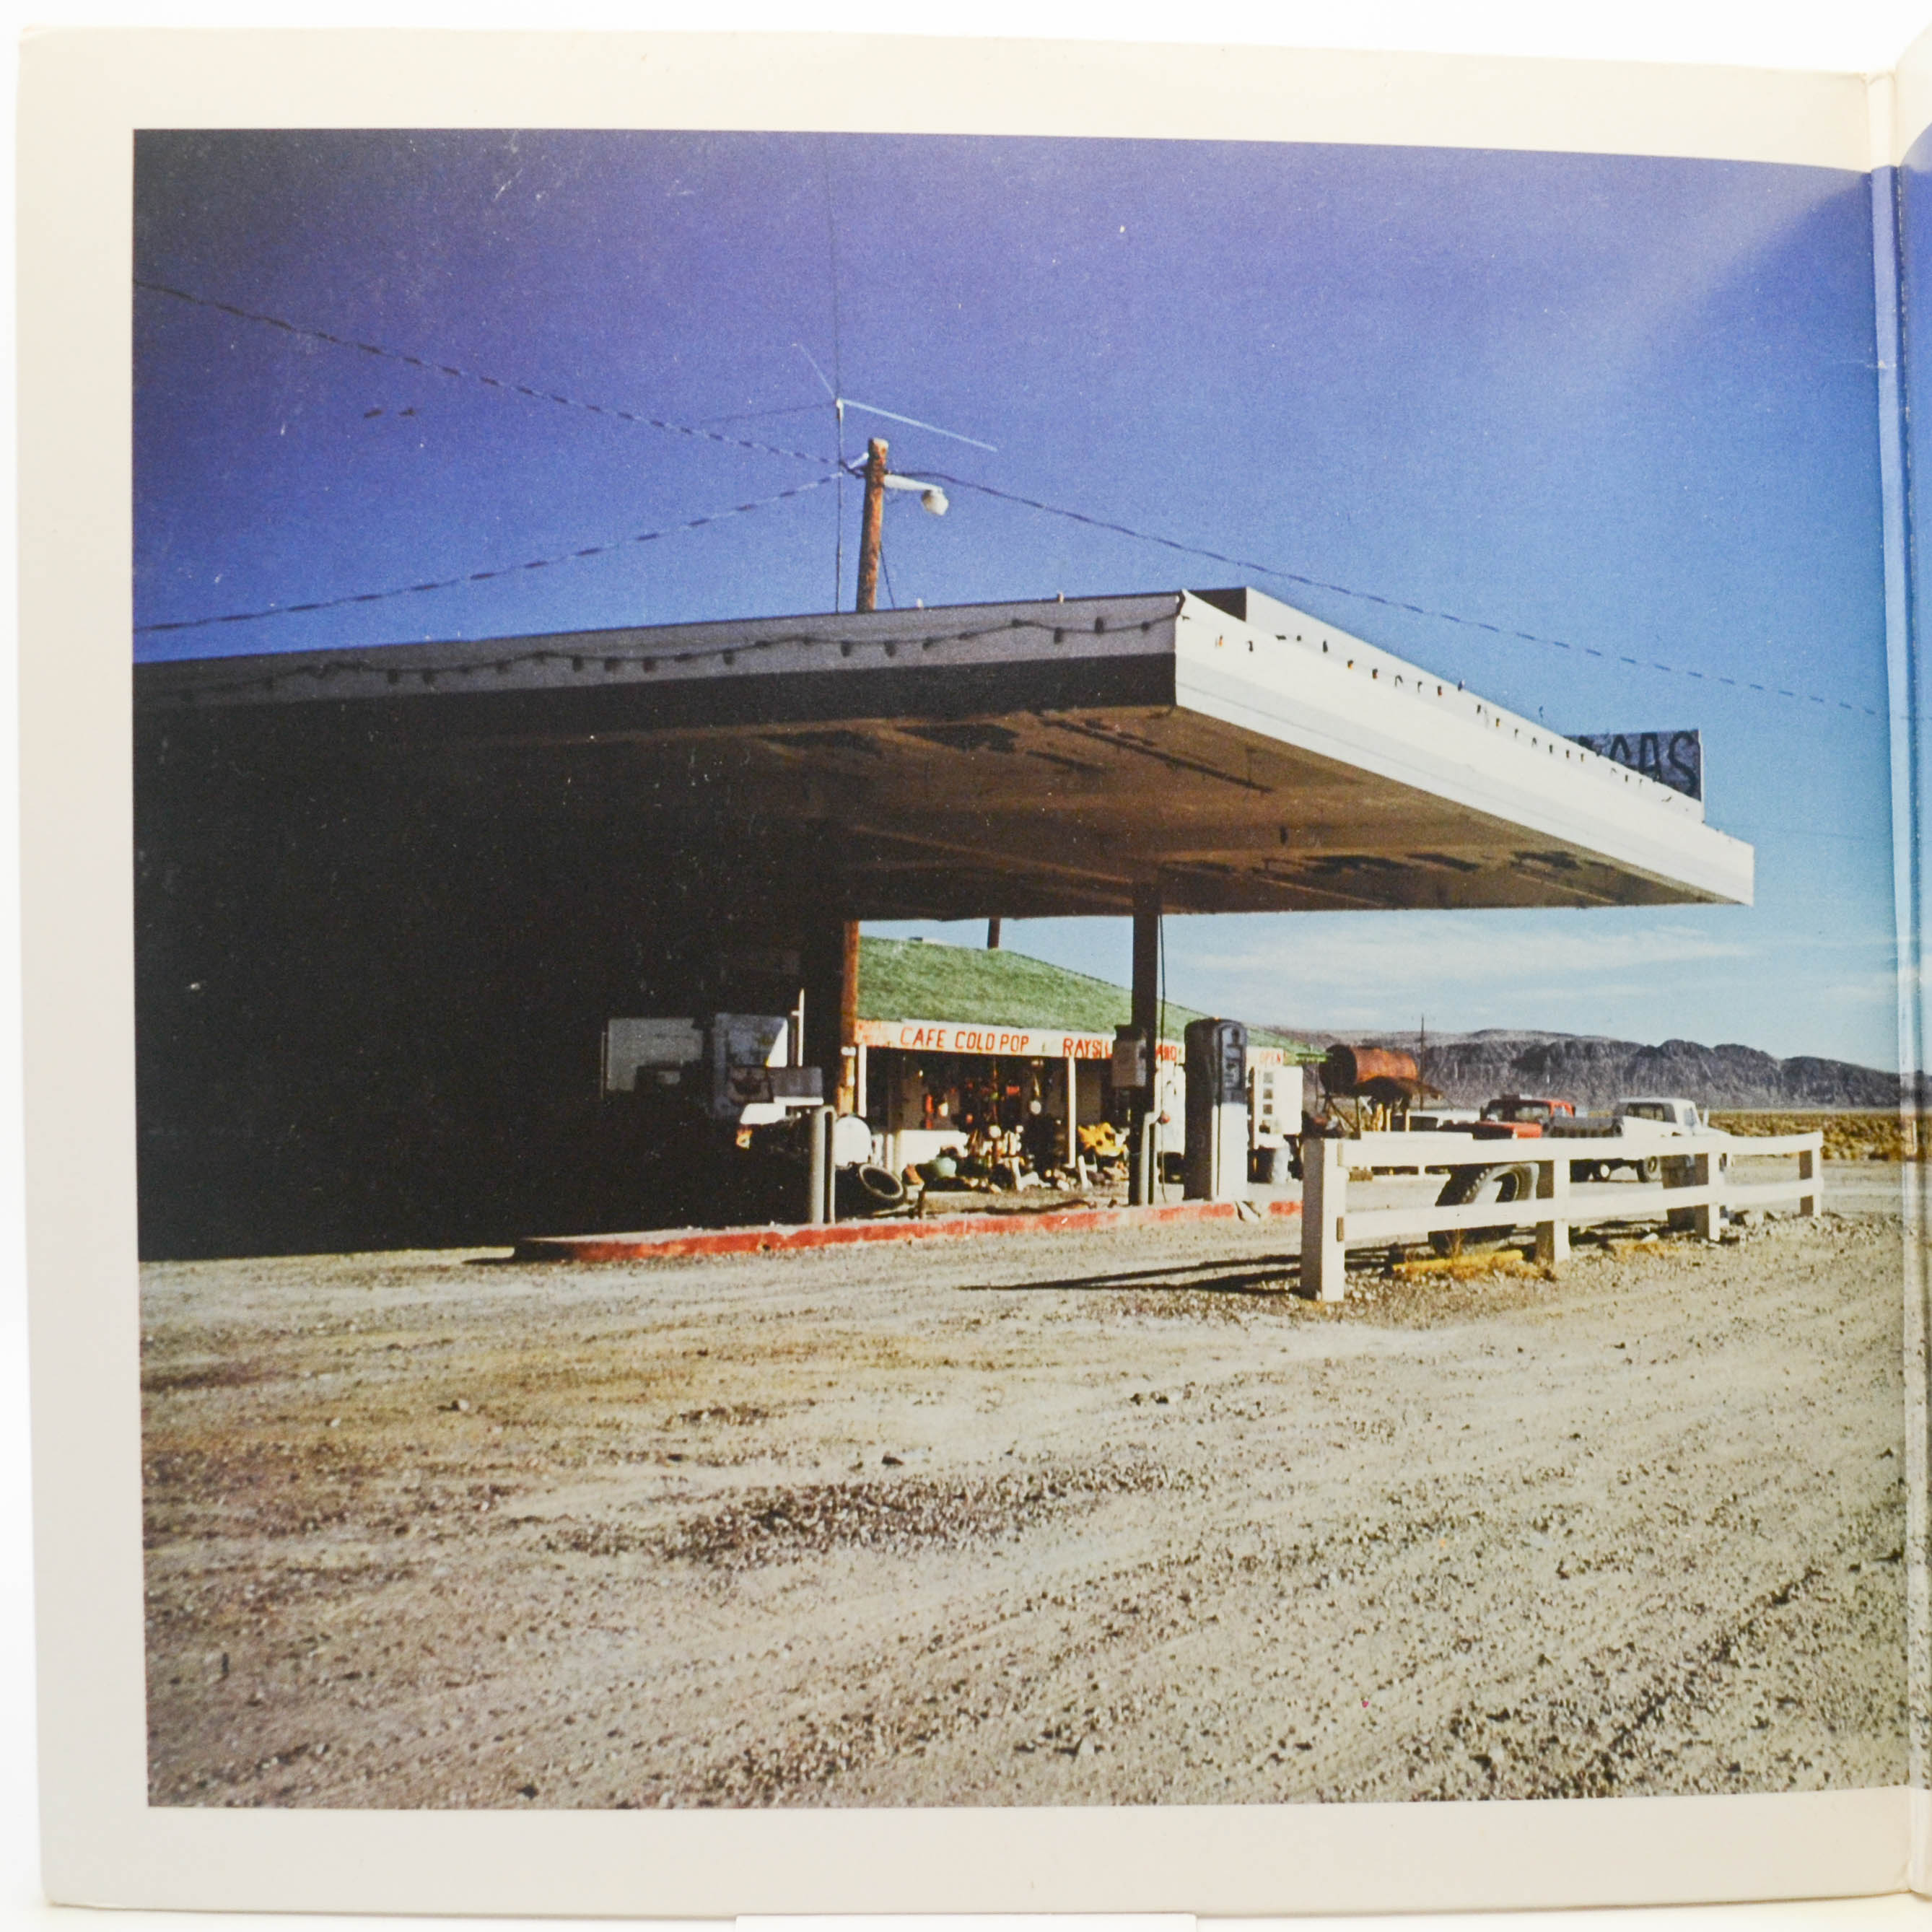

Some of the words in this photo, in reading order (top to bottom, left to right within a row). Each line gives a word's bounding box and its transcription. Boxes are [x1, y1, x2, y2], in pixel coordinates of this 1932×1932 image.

[900, 1027, 947, 1048] CAFE
[955, 1031, 995, 1052] COLD
[1000, 1033, 1029, 1052] POP
